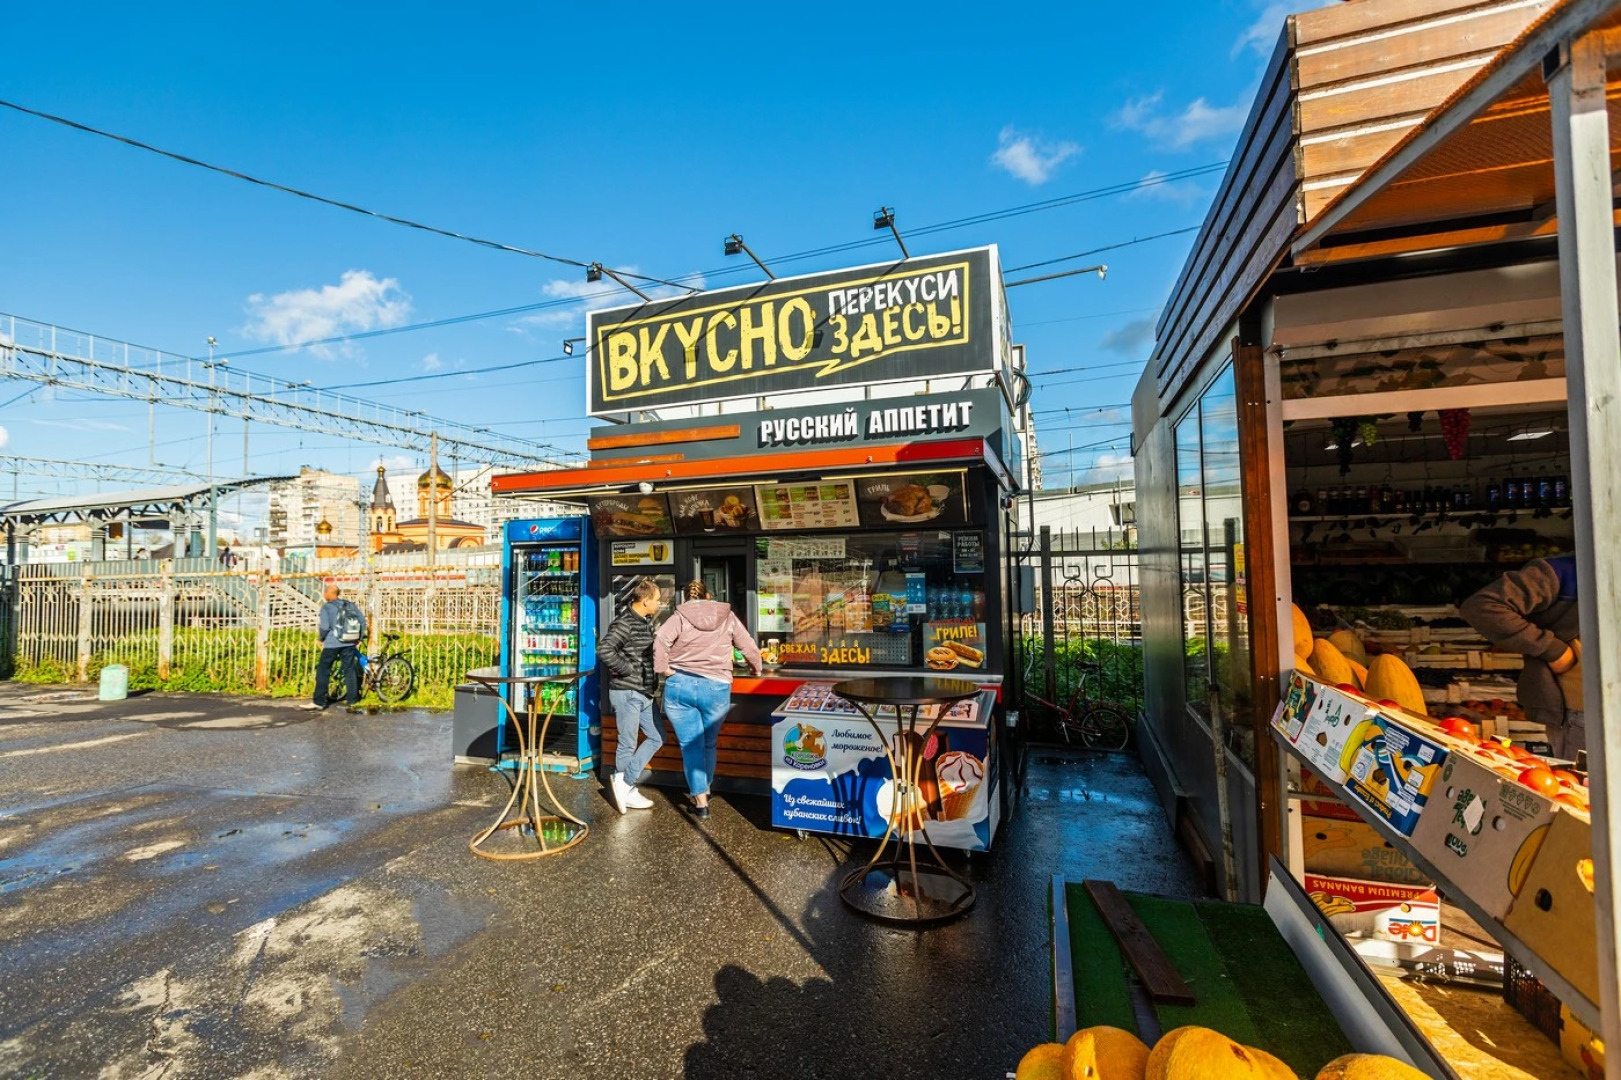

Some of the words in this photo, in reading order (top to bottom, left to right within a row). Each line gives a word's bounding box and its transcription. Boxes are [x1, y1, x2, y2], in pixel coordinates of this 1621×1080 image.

[828, 270, 958, 317] ПЕРЕКУСИ
[828, 295, 962, 358] ЗДЕСЬ!
[608, 297, 815, 391] ВКУСНО
[760, 407, 858, 443] РУССКИЙ
[869, 401, 973, 434] АППЕТИТ
[936, 624, 977, 640] ГРИЛЕ!
[780, 643, 816, 654] СВЕЖАЯ
[820, 647, 871, 664] ЗДЕСЬ!
[831, 729, 872, 740] Любимое
[831, 743, 883, 753] мороженое!
[783, 794, 795, 807] Из
[797, 795, 845, 809] свежайших
[783, 808, 828, 820] кубанских
[828, 813, 862, 825] сливок!
[1313, 880, 1365, 894] BANANAS
[1368, 887, 1420, 899] PREMIUM
[1388, 921, 1437, 942] Dole
